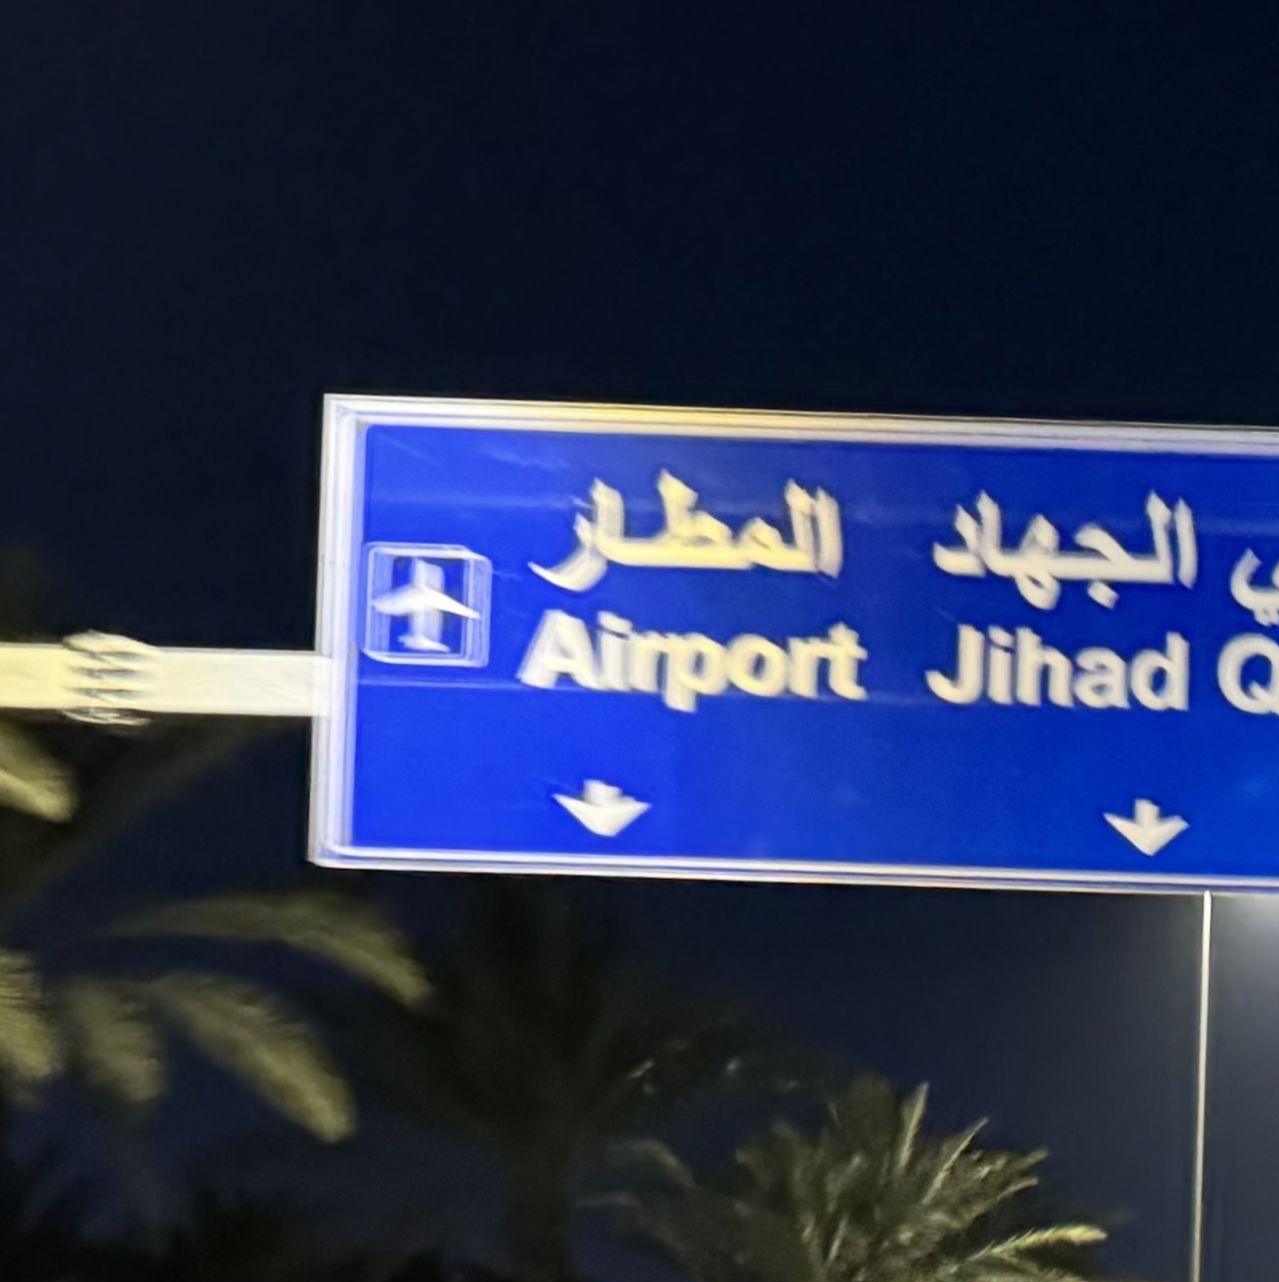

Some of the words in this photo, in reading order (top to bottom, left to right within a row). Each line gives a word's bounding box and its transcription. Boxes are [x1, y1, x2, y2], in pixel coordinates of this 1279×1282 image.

[527, 469, 844, 593] المطار
[932, 492, 1197, 611] الجهاد
[515, 608, 869, 714] Airport
[925, 623, 1190, 712] Jihad
